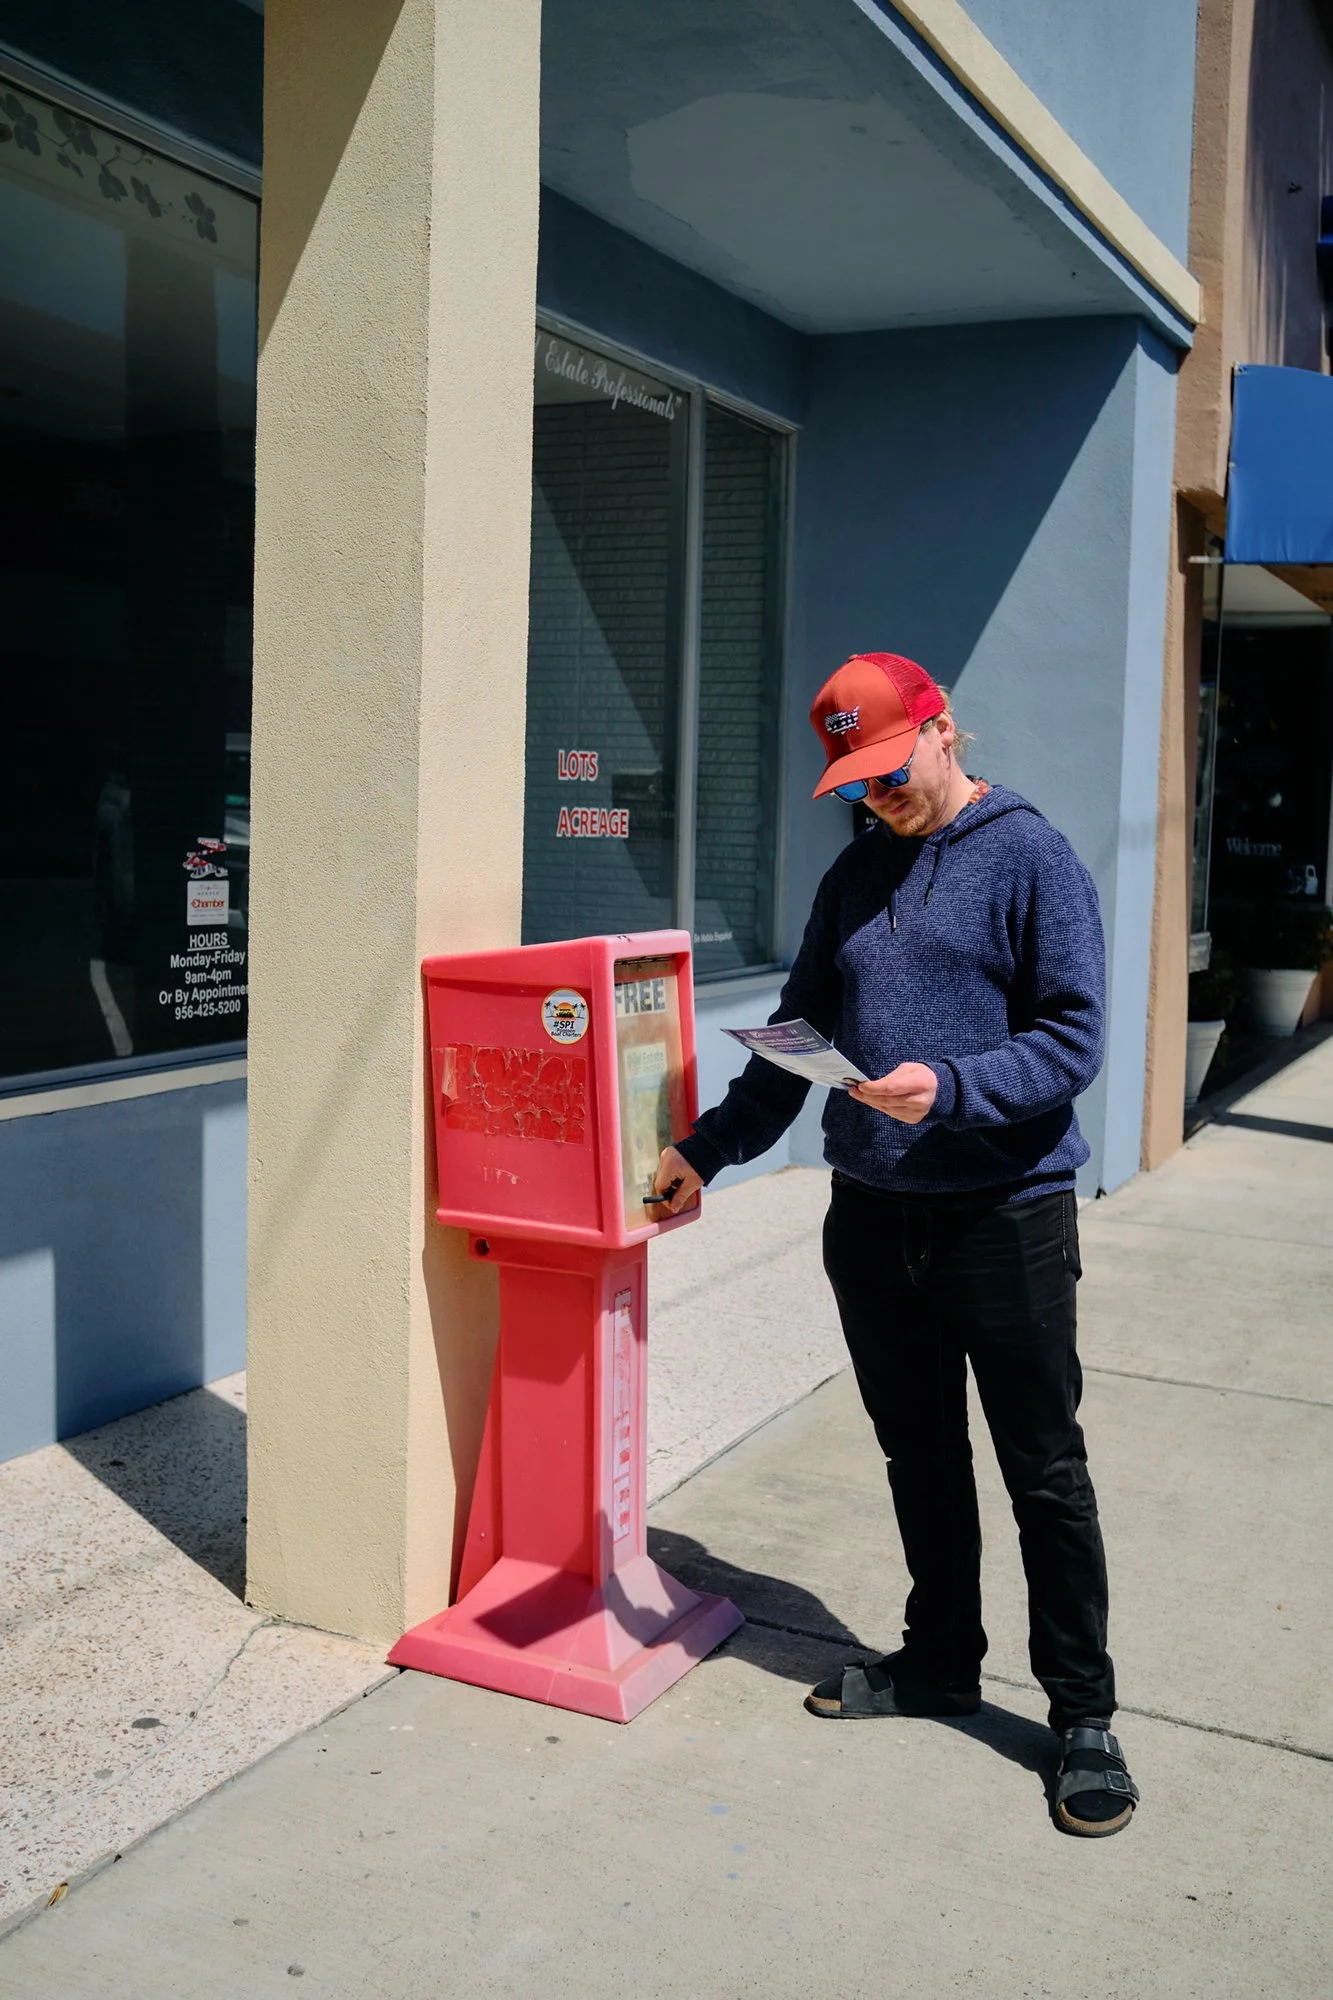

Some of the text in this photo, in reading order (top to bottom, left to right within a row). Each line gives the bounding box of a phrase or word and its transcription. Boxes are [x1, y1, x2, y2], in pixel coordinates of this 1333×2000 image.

[545, 340, 589, 385] Estate
[558, 749, 599, 782] LOTS
[556, 807, 629, 838] ACREAGE
[1226, 837, 1282, 856] Welcome
[191, 898, 225, 908] Chamber
[189, 931, 228, 948] HOURS
[170, 949, 246, 968] Monday-Friday
[185, 968, 232, 984] 9am-4pm
[159, 990, 173, 1005] Or
[175, 988, 190, 1005] By
[614, 978, 666, 1016] FREE
[174, 999, 241, 1020] 956-425-5200
[553, 1020, 575, 1029] #SPI
